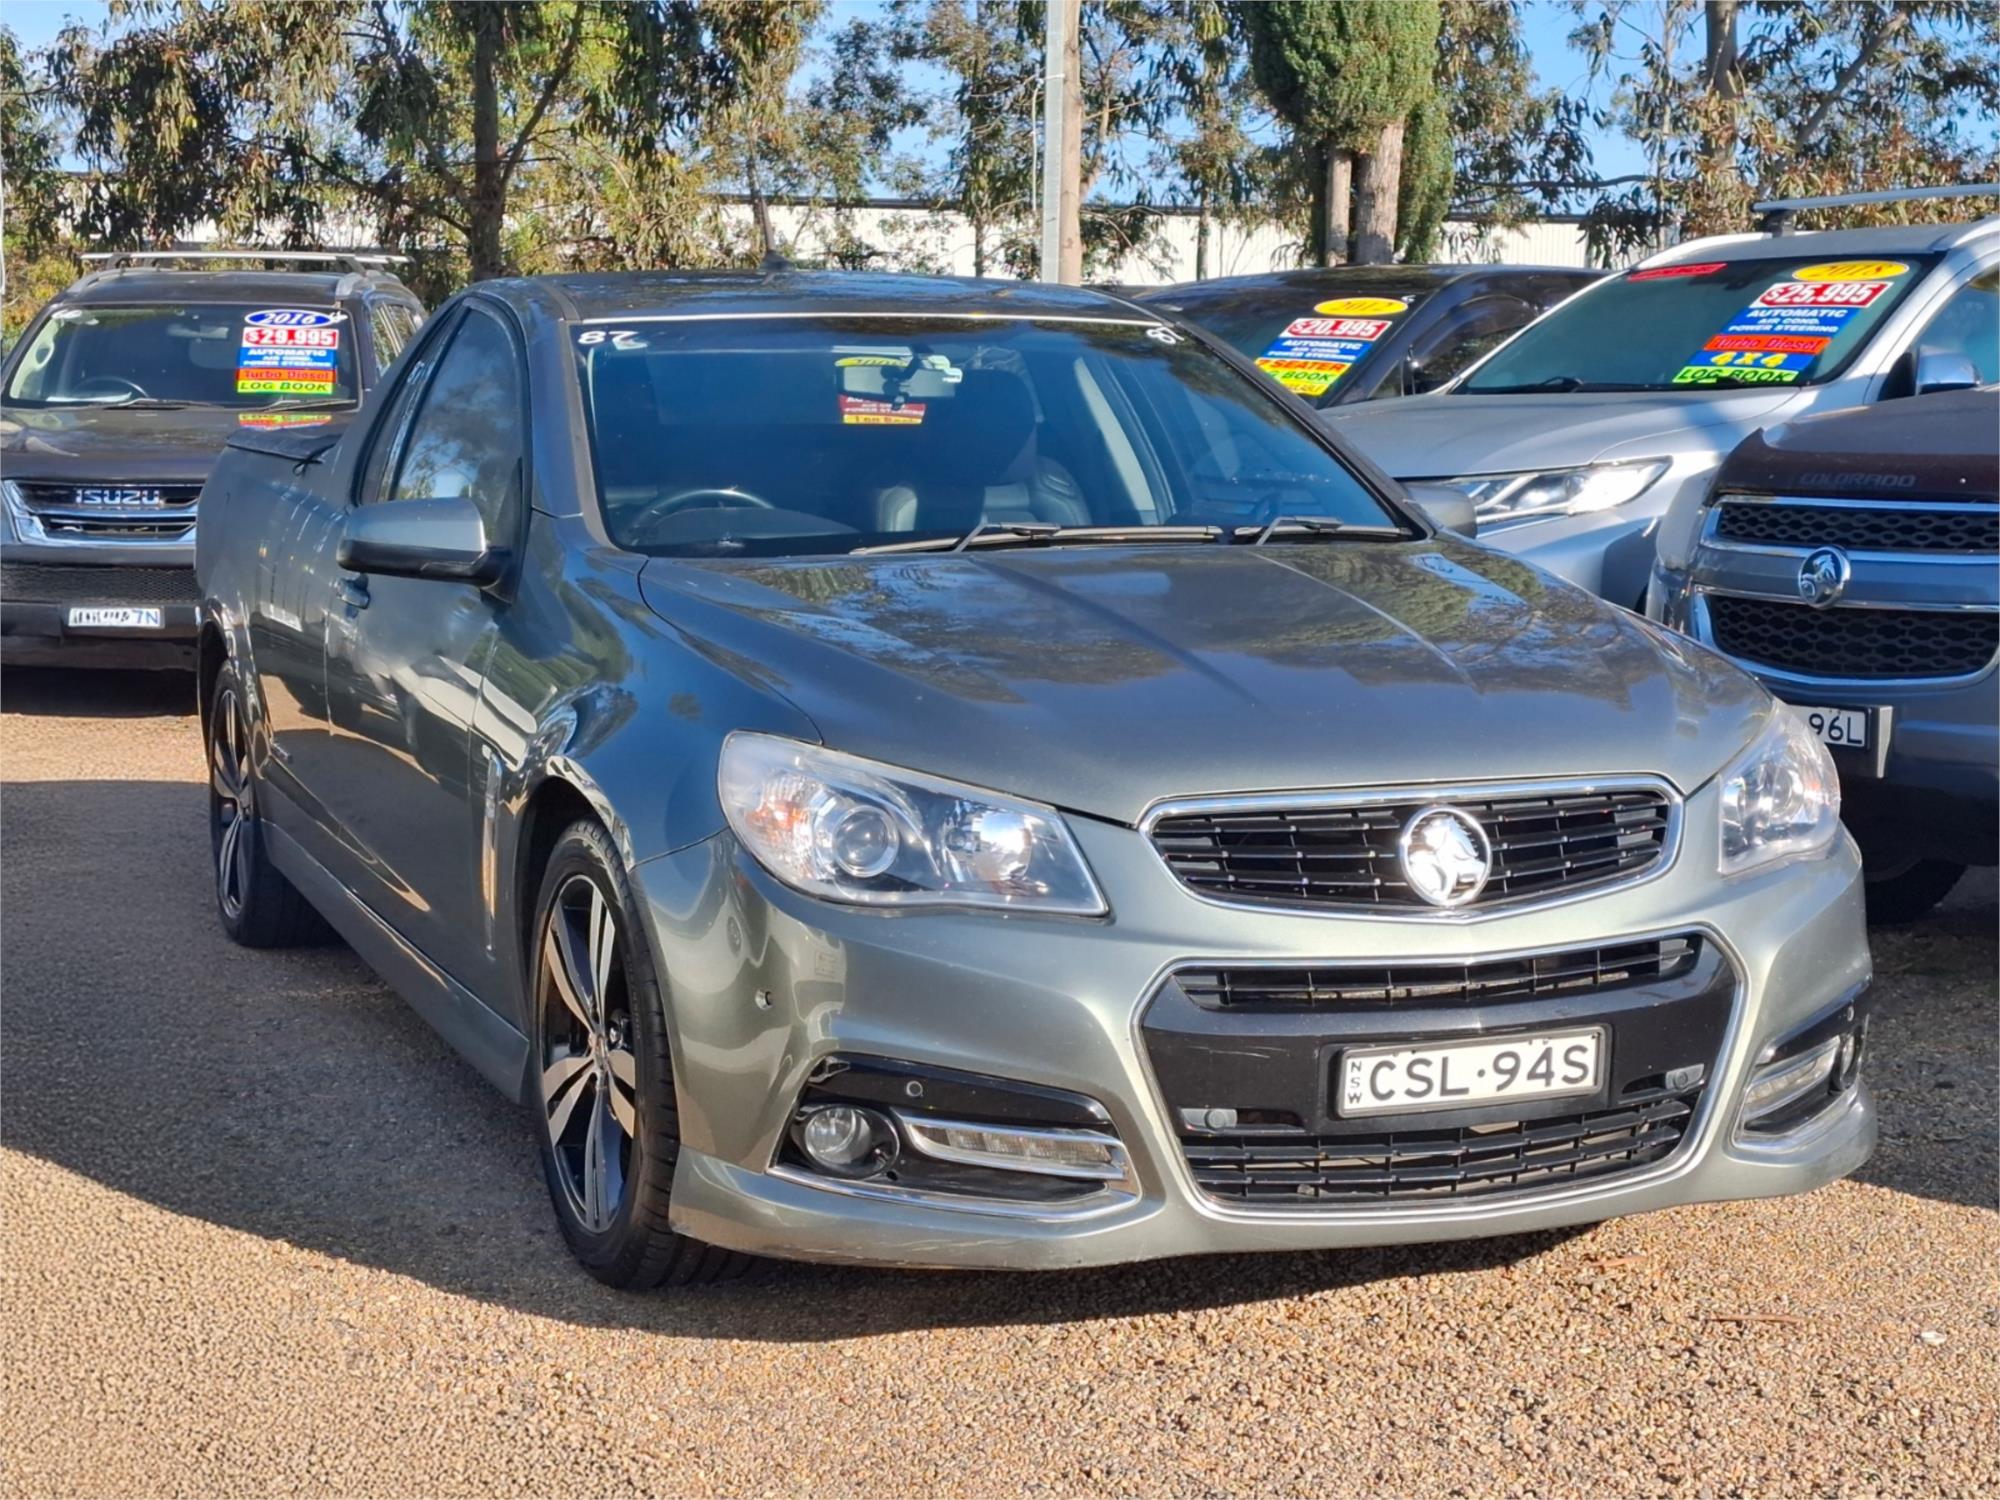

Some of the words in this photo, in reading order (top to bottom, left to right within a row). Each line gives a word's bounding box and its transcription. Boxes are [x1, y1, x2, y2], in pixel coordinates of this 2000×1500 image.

[1765, 283, 1874, 303] $25,995
[263, 313, 316, 324] 2016
[1747, 309, 1847, 318] AUTOMATIC
[1775, 325, 1839, 333] STEERING
[1282, 339, 1363, 350] AUTOMATIC
[1716, 338, 1760, 348] Turbo
[1766, 338, 1822, 350] Diesel
[1270, 360, 1346, 371] SEATER
[245, 370, 282, 379] Turbo
[287, 370, 329, 379] Diesel
[1282, 371, 1334, 381] BOOK
[1679, 369, 1721, 379] LOG
[1727, 370, 1793, 381] BOOK
[240, 382, 273, 390] LOG
[280, 382, 328, 391] BOOK
[1801, 472, 1916, 487] COLORADO
[75, 489, 160, 505] ISUZU
